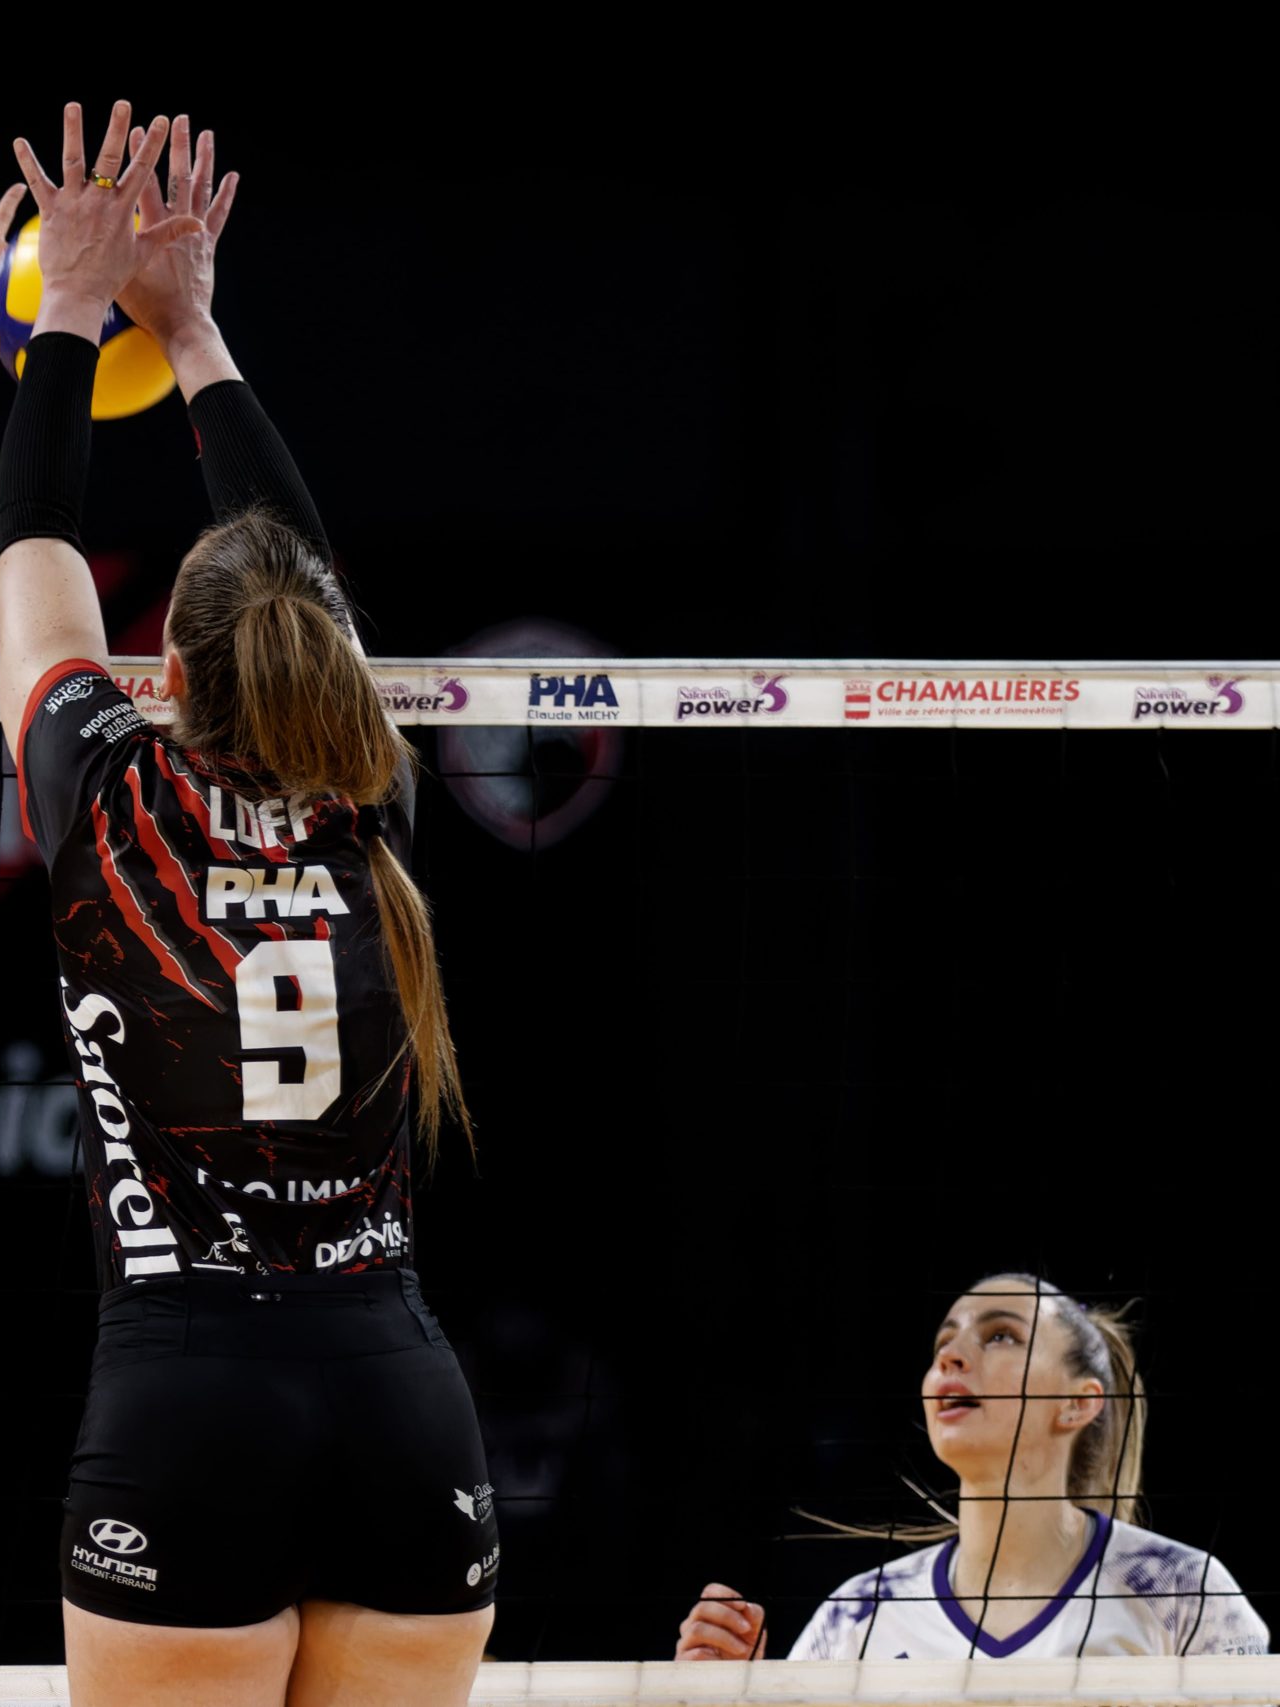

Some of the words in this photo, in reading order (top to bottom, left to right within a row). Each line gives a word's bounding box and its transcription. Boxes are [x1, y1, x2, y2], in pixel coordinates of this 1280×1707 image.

[528, 673, 619, 708] PHA
[527, 709, 572, 721] Claude
[577, 711, 620, 721] MICHY
[877, 707, 903, 716] Ville
[906, 707, 919, 716] de
[979, 707, 991, 715] et
[206, 865, 351, 919] PHA
[235, 940, 342, 1121] 9
[70, 1558, 157, 1592] CLERMONT-FERRAND
[72, 1545, 158, 1582] HYUNDAI
